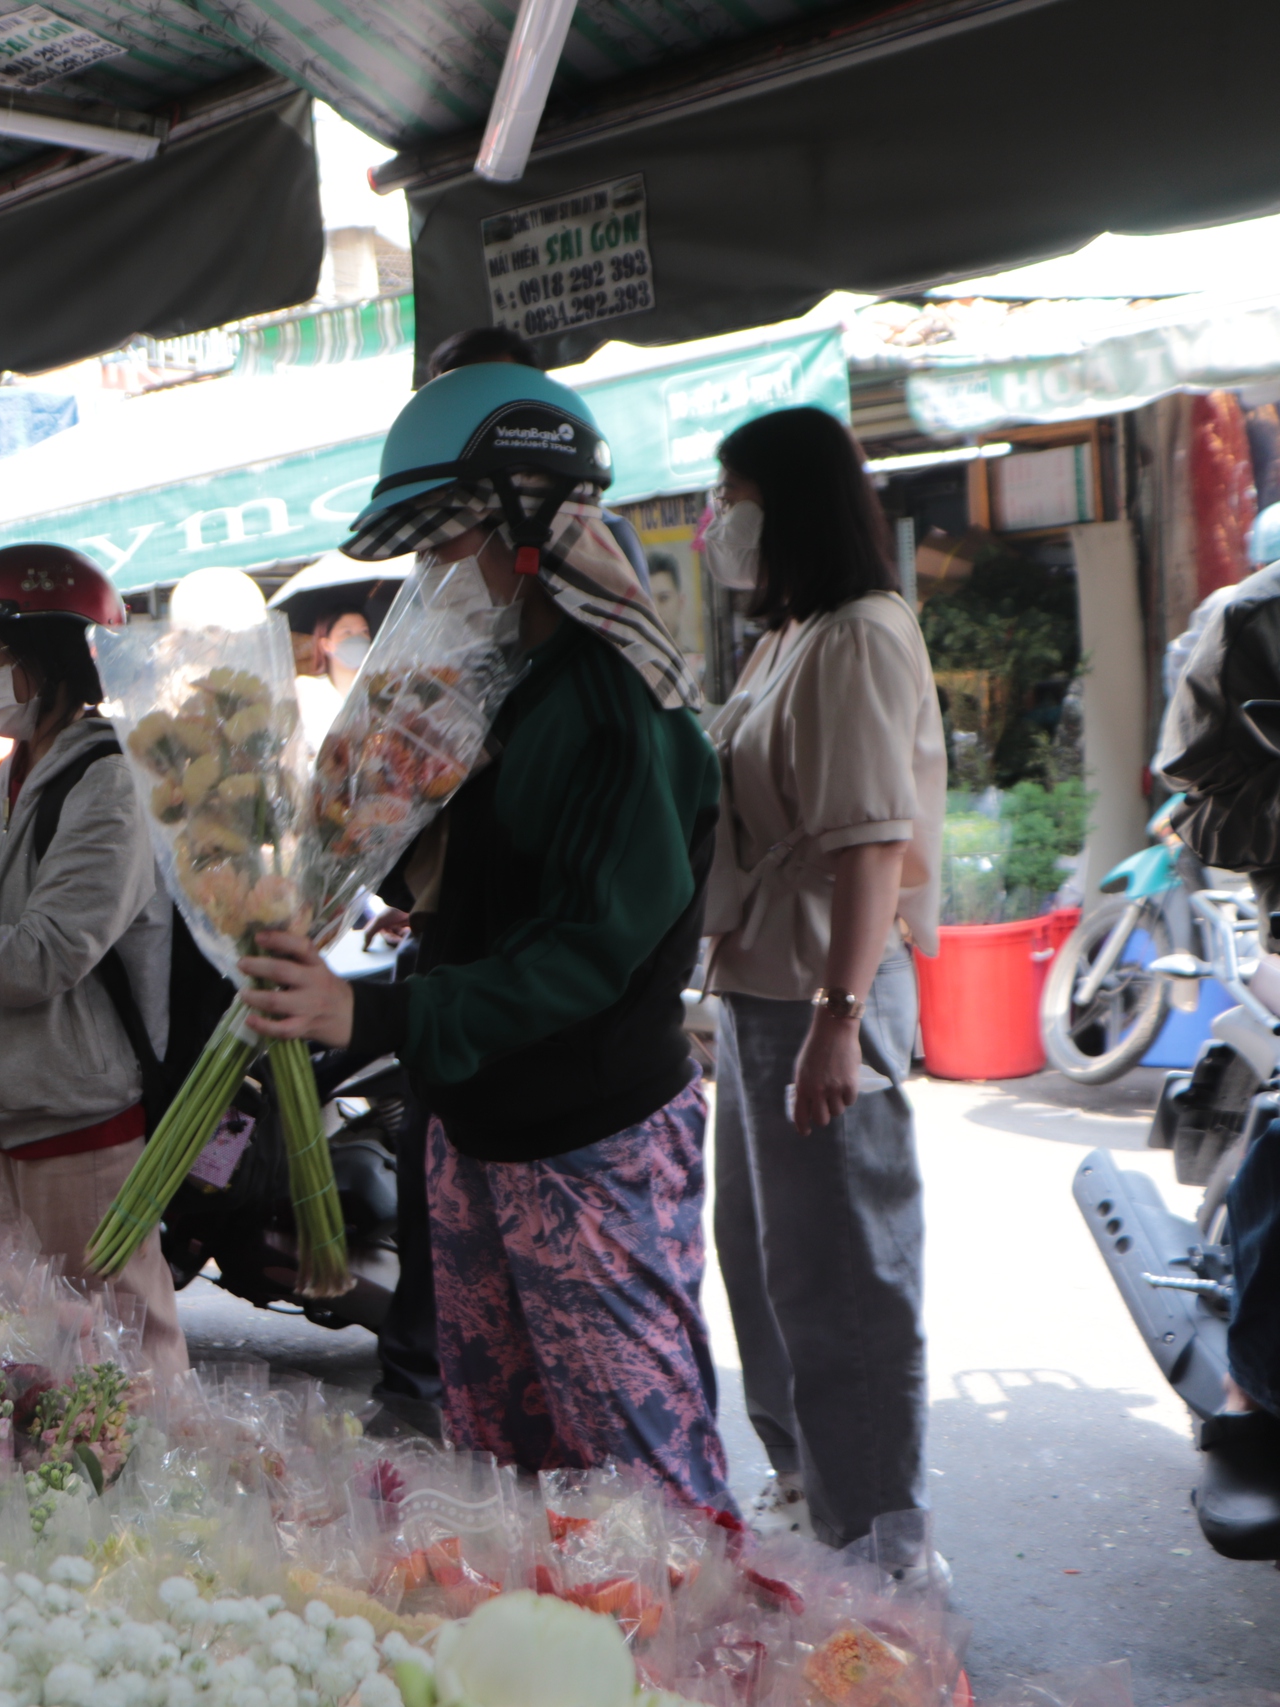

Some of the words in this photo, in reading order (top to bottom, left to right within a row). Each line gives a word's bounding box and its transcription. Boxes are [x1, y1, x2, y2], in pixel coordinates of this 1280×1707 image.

[488, 250, 510, 278] MÁI
[511, 243, 540, 271] HIÊN
[545, 225, 583, 267] SÀI
[590, 210, 642, 253] GÒN
[519, 271, 564, 305] 0918
[569, 260, 606, 292] 292
[610, 249, 649, 282] 393
